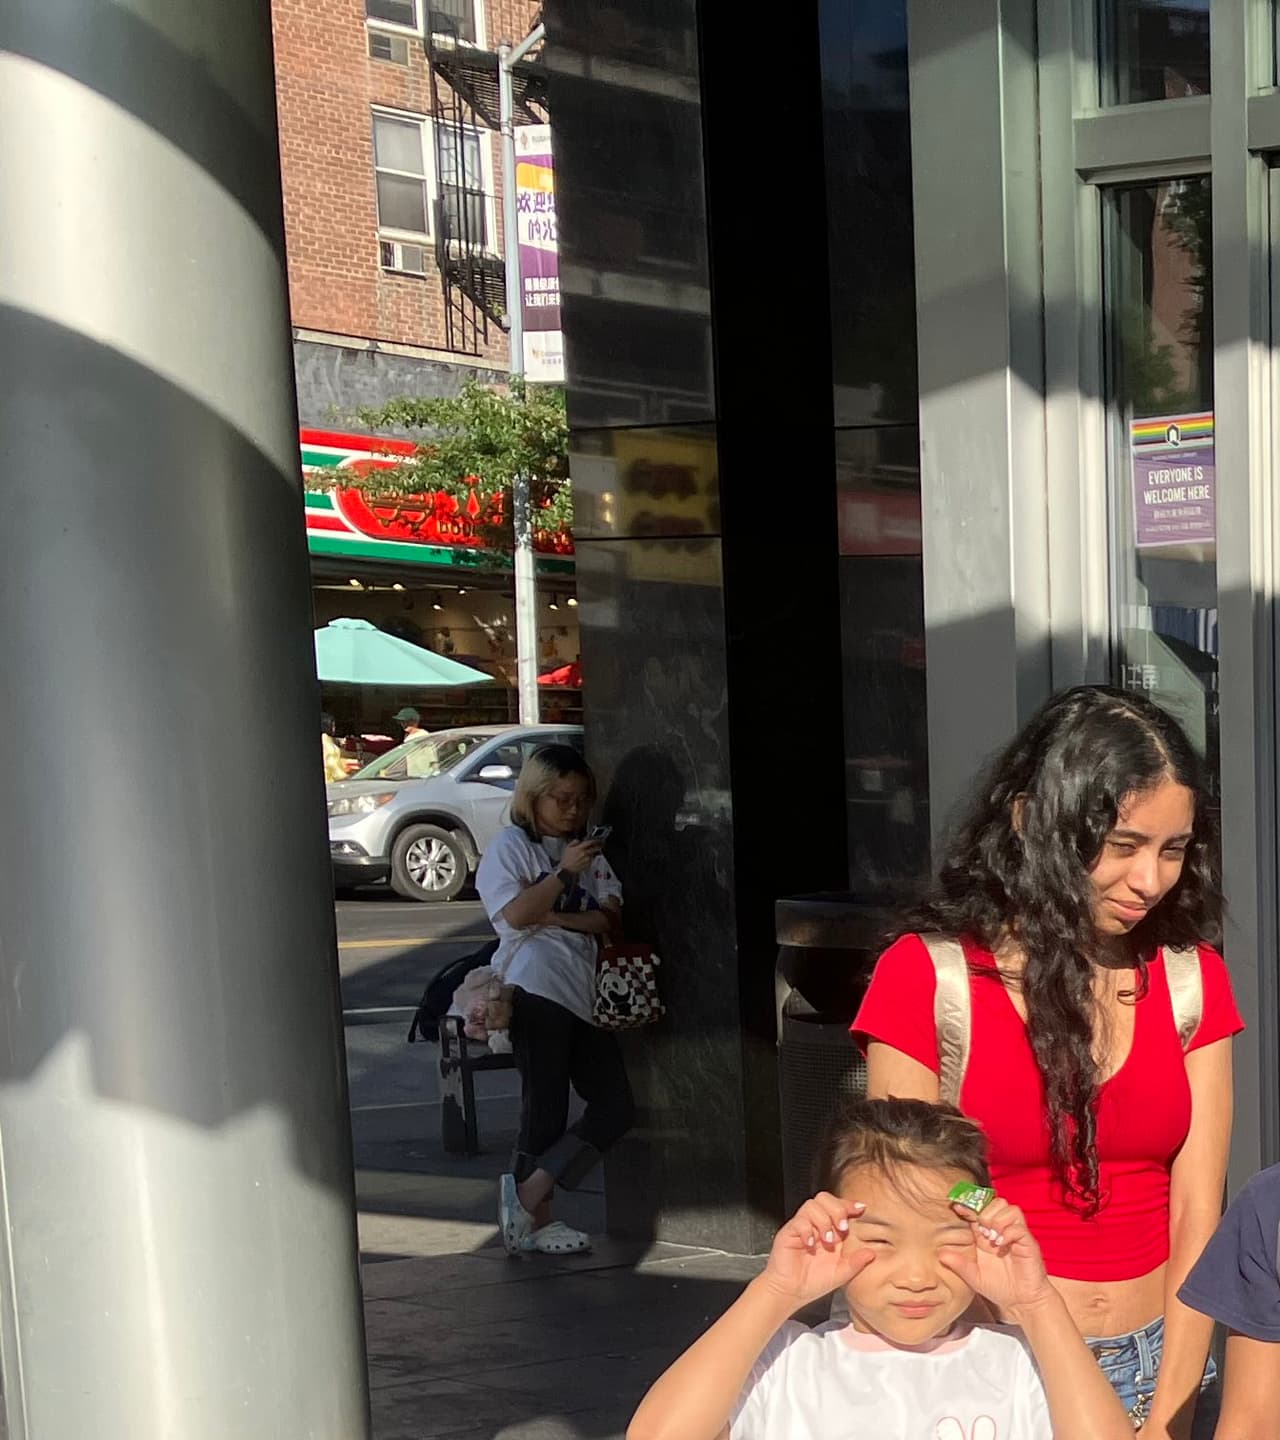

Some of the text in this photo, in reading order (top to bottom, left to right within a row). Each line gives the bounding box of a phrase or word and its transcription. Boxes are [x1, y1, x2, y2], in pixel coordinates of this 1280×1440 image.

[1148, 466, 1204, 485] EVERYONE IS
[1144, 485, 1210, 504] WELCOME HERE
